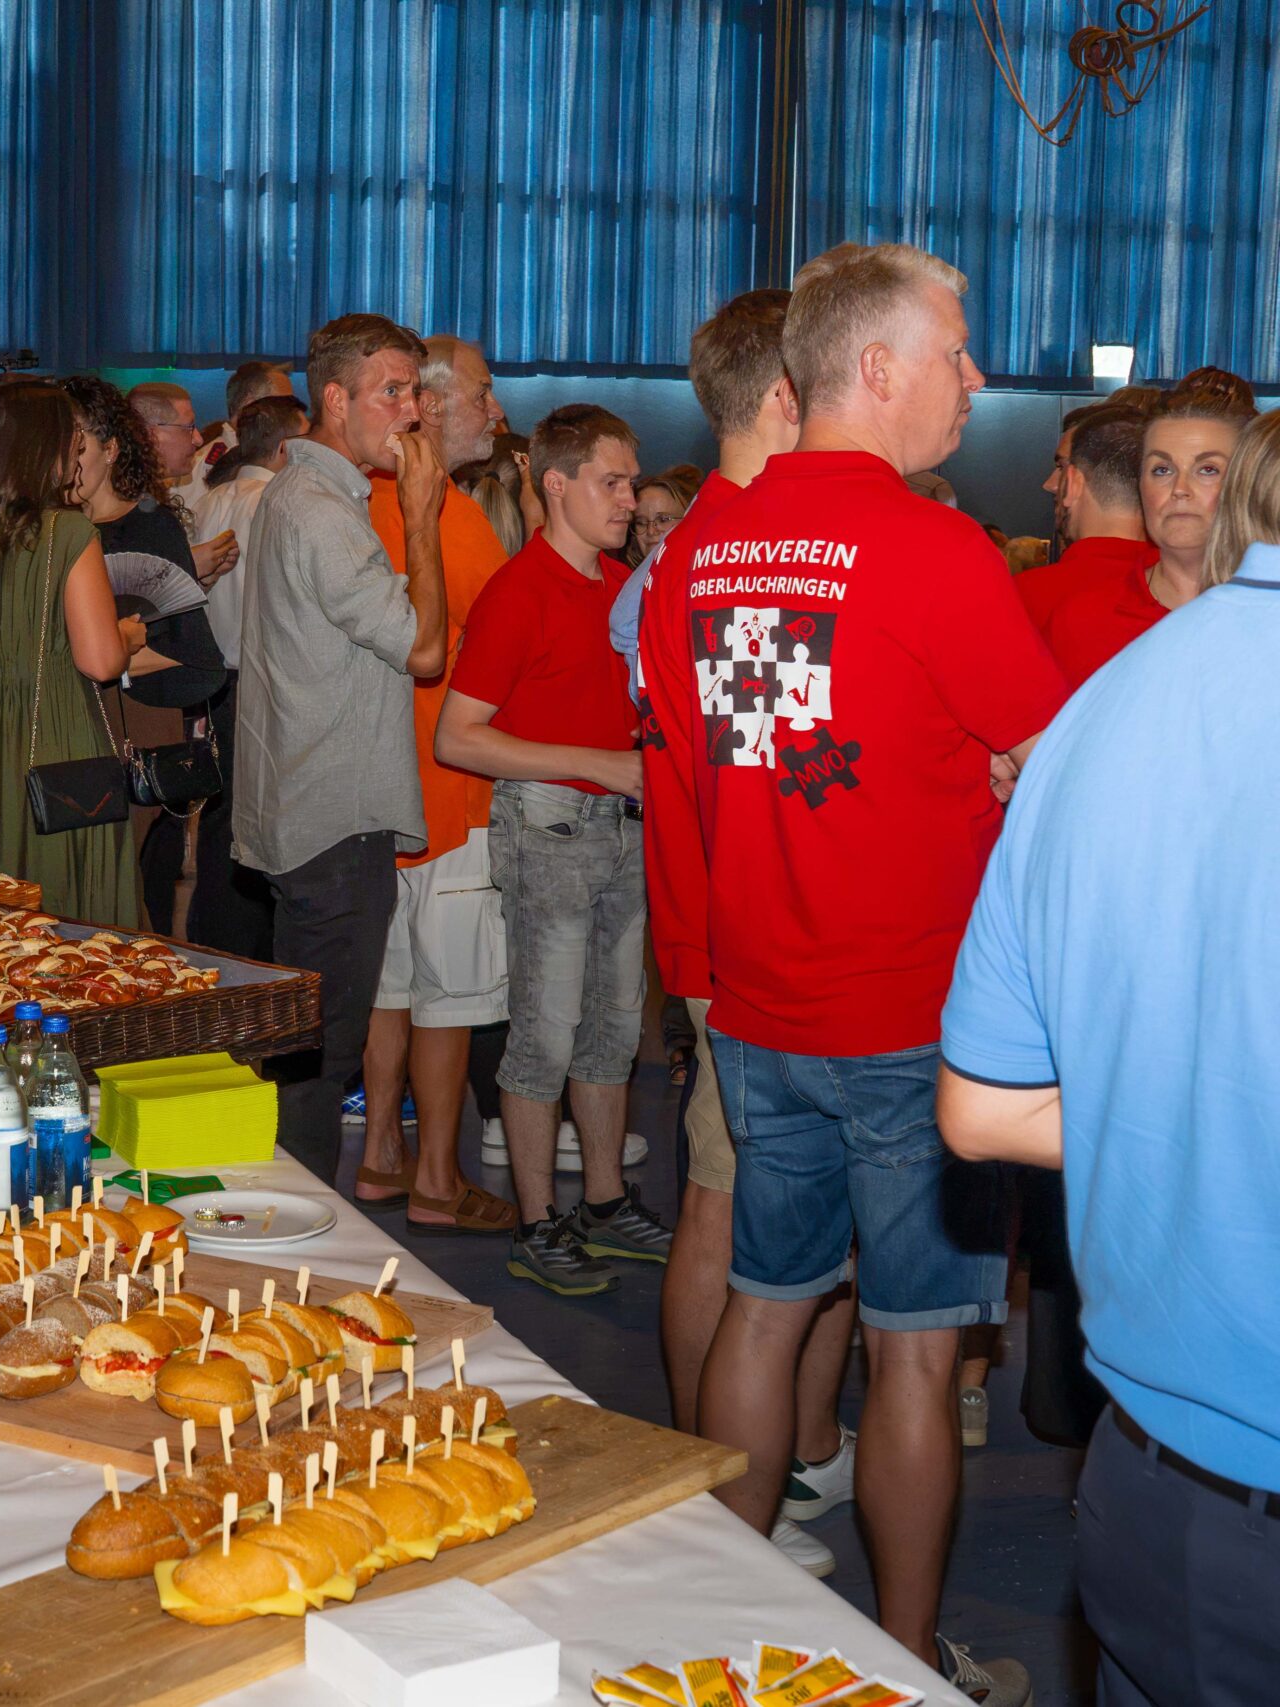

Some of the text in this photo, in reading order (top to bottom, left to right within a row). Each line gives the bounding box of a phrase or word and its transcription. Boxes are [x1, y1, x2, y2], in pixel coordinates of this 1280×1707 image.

[692, 539, 858, 571] MUSIKVEREIN
[689, 576, 847, 601] OBERLAUCHRINGEN
[794, 749, 846, 791] MVO
[785, 1685, 812, 1705] SENF
